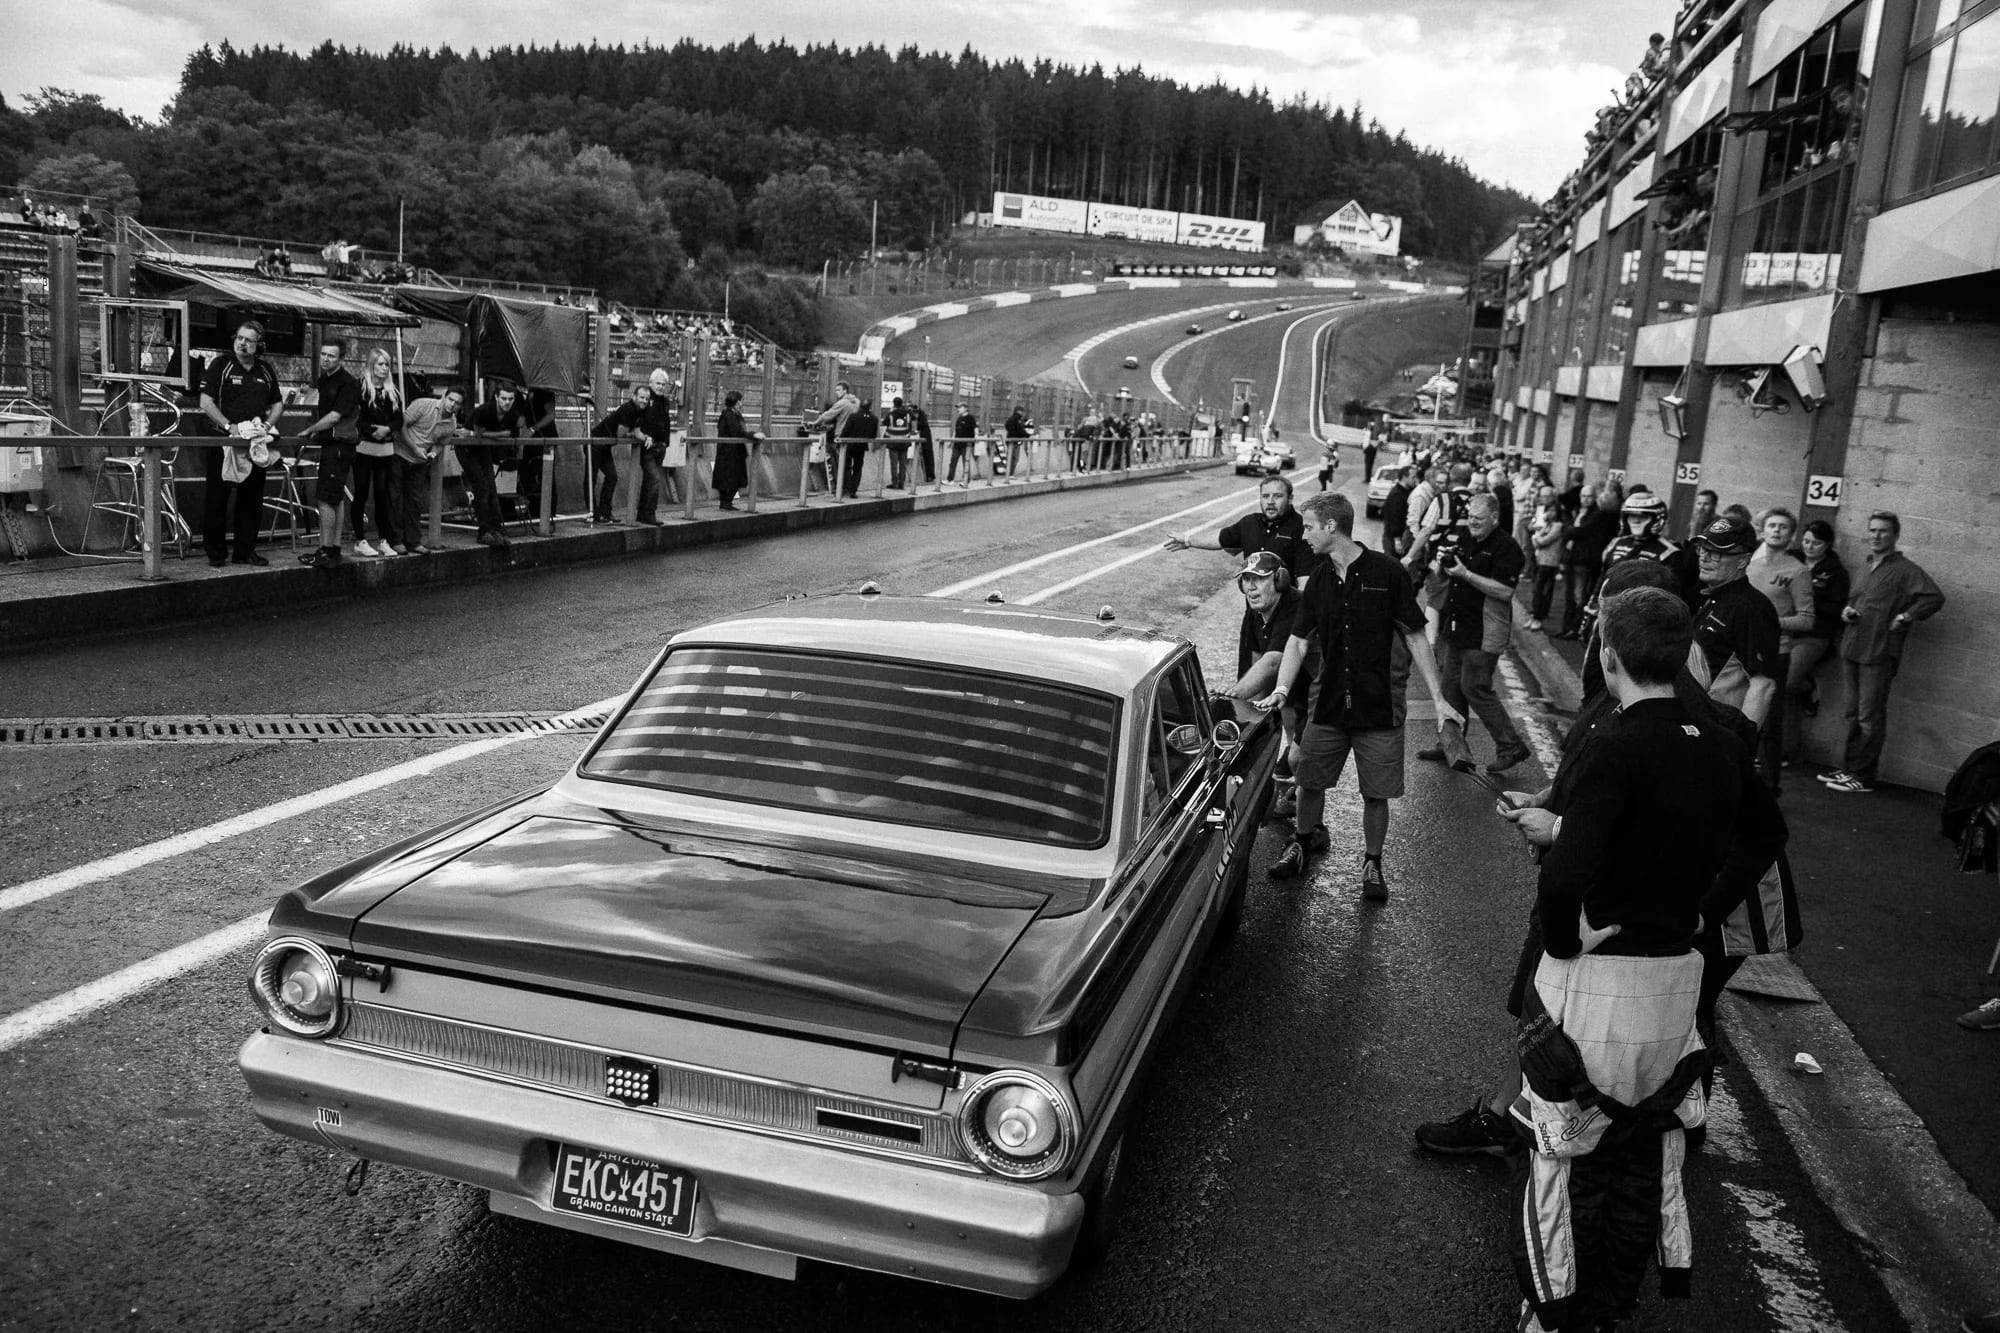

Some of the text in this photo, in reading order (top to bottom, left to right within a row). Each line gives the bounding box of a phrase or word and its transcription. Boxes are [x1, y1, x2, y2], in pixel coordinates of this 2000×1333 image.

[1030, 199, 1059, 212] ALD
[1104, 210, 1174, 226] CIRCUIT DE SPA
[1187, 222, 1254, 243] DHL
[884, 384, 897, 393] 50
[1678, 464, 1699, 481] 35
[1809, 480, 1839, 501] 34
[1769, 575, 1793, 588] JW
[319, 1108, 339, 1125] TOW
[562, 1154, 683, 1216] EKC 451
[569, 1196, 675, 1225] GRAND CANYON STATE
